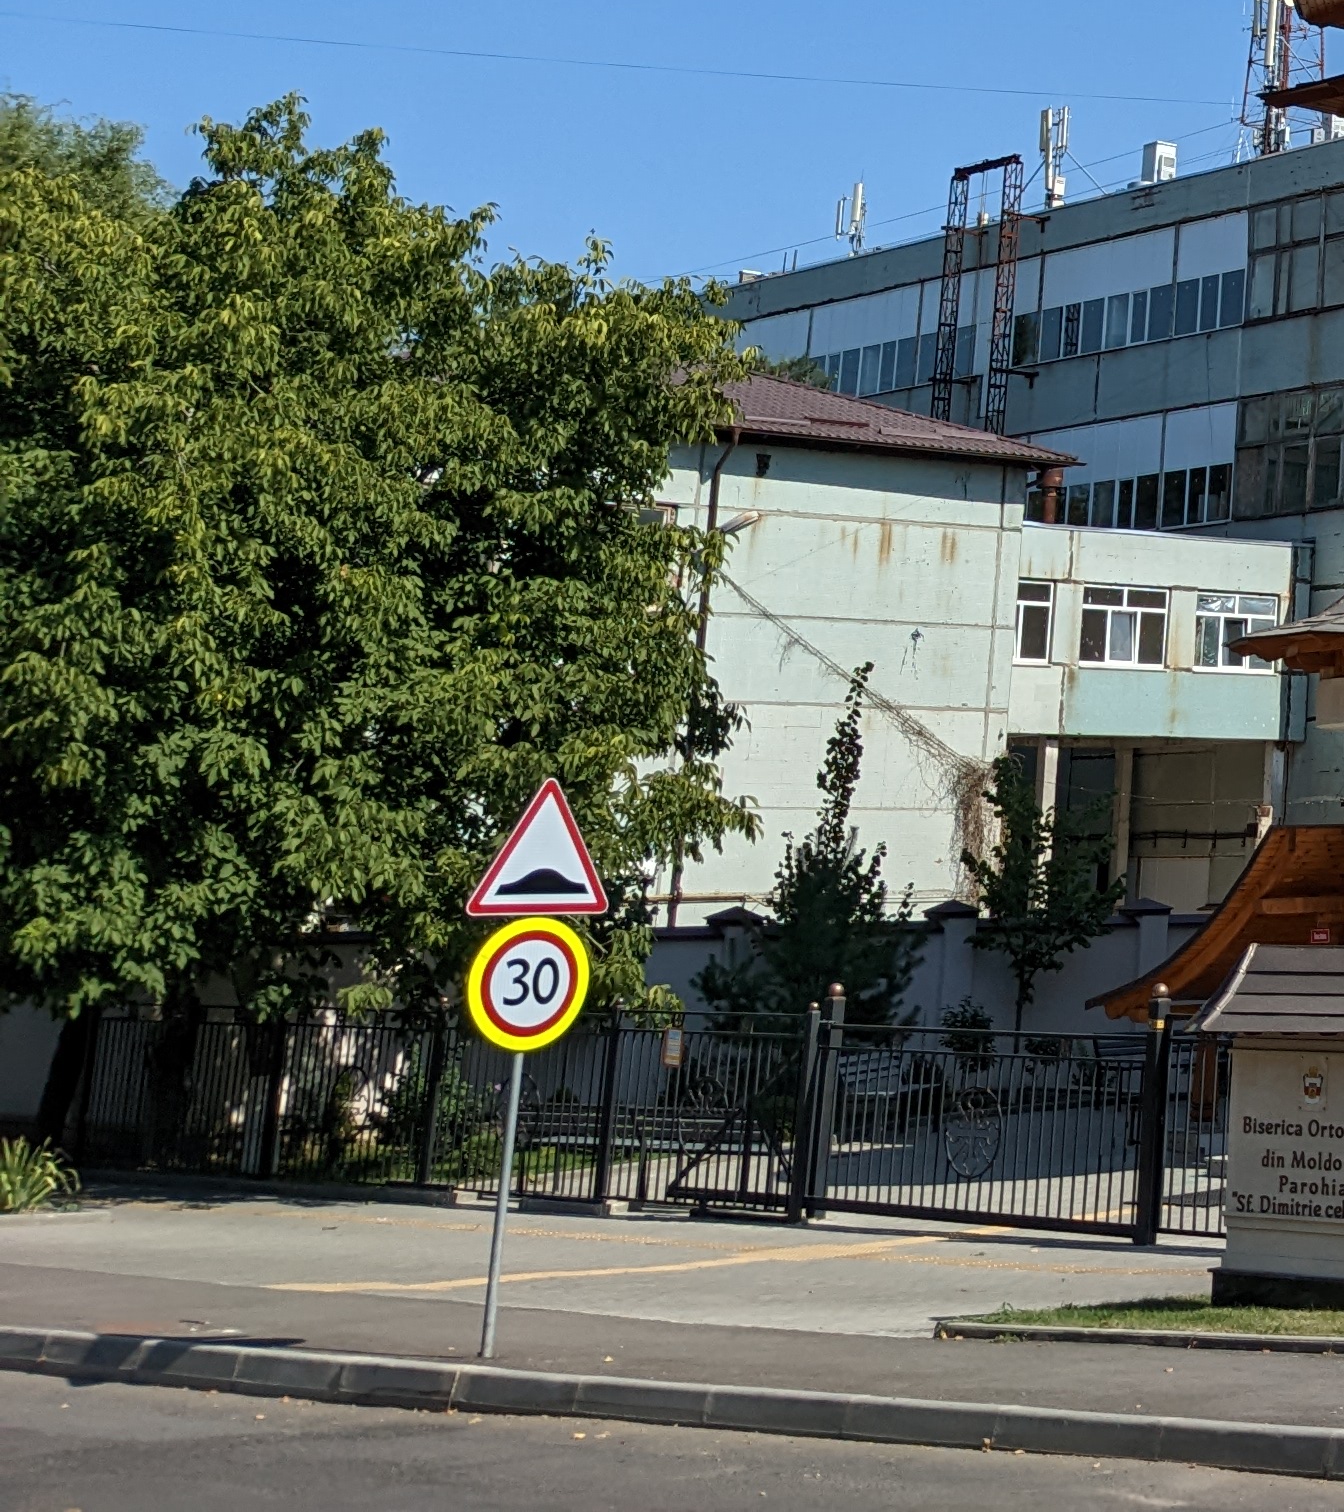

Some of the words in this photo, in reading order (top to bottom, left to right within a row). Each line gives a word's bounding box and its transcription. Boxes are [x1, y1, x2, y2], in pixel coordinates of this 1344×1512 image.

[502, 956, 560, 1006] 30
[1243, 1116, 1303, 1137] Biserica
[1261, 1148, 1285, 1168] din
[1260, 1195, 1322, 1217] Dimitrie
